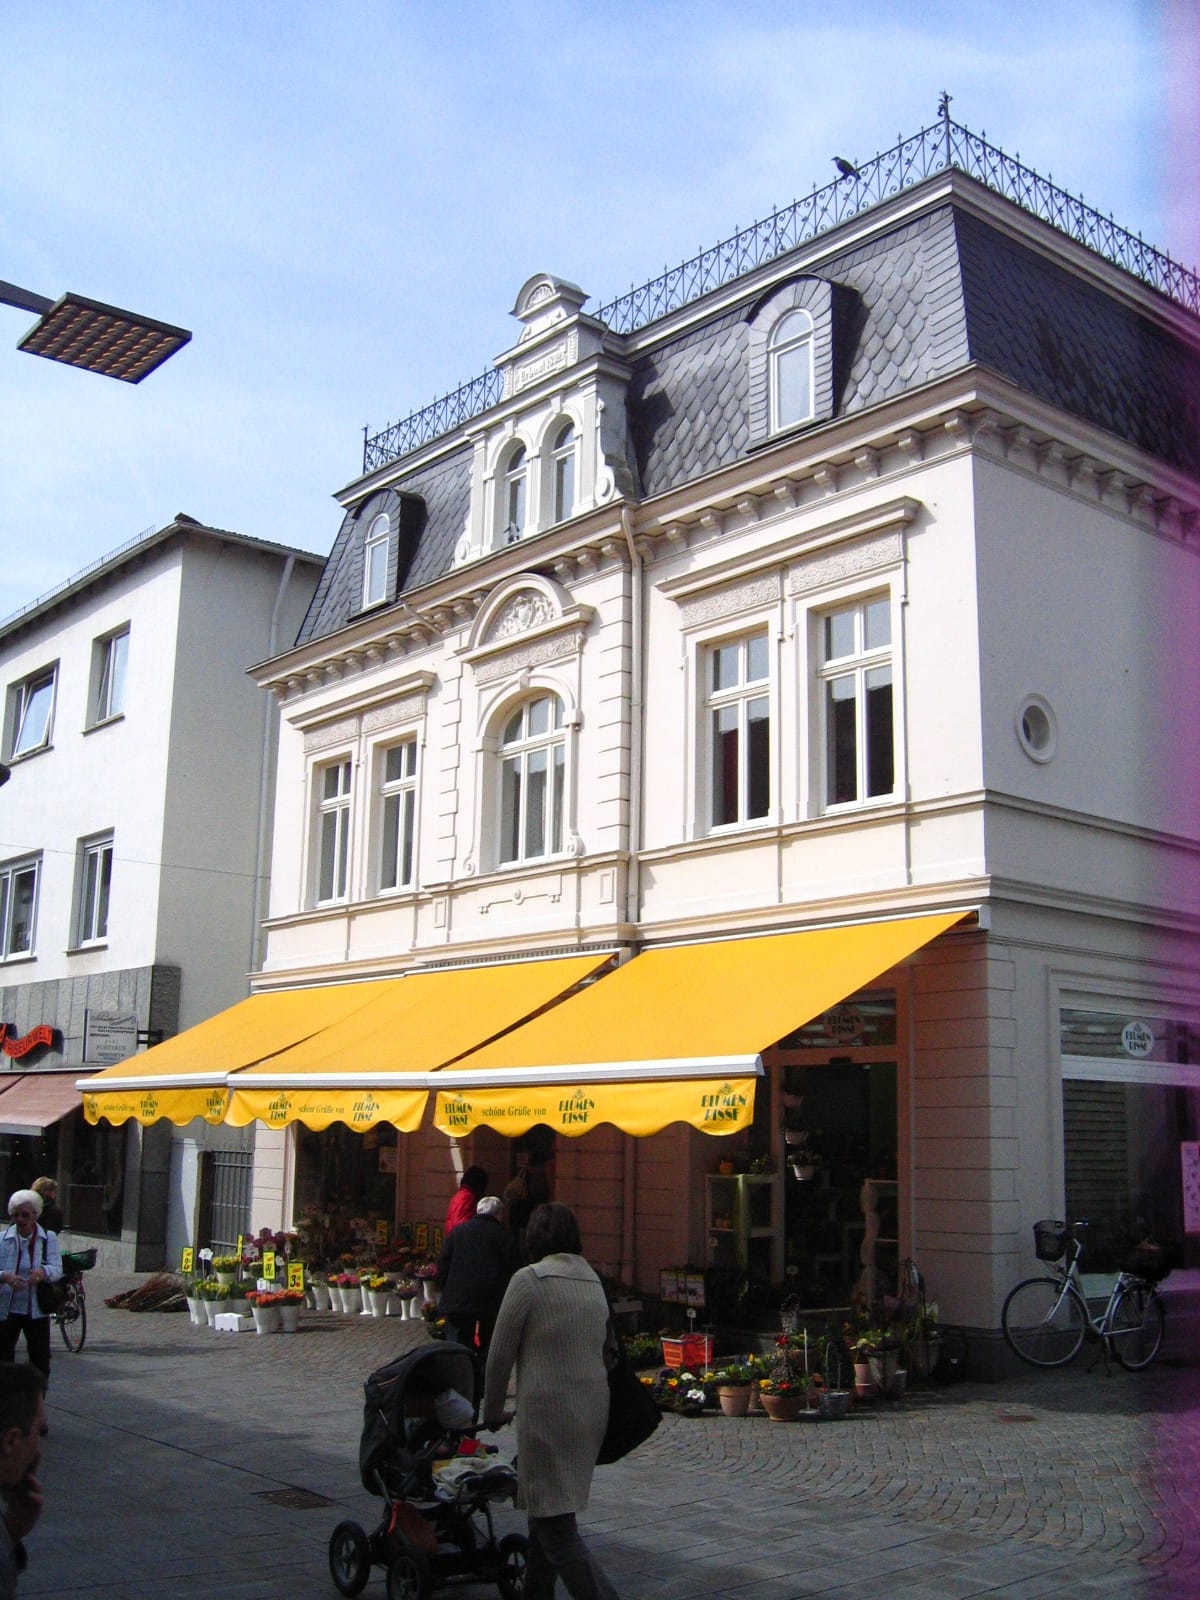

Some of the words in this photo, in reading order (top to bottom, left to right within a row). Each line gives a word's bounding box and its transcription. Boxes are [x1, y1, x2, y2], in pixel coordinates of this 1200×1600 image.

[559, 1099, 595, 1111] BLUMEN
[701, 1094, 746, 1107] BLUMEN
[445, 1103, 472, 1114] BLUMEN
[482, 1106, 505, 1117] schöne
[508, 1106, 531, 1117] Grüße
[534, 1107, 547, 1116] von
[704, 1108, 738, 1121] RISSE
[449, 1114, 468, 1125] RISSE
[562, 1111, 589, 1124] RISSE
